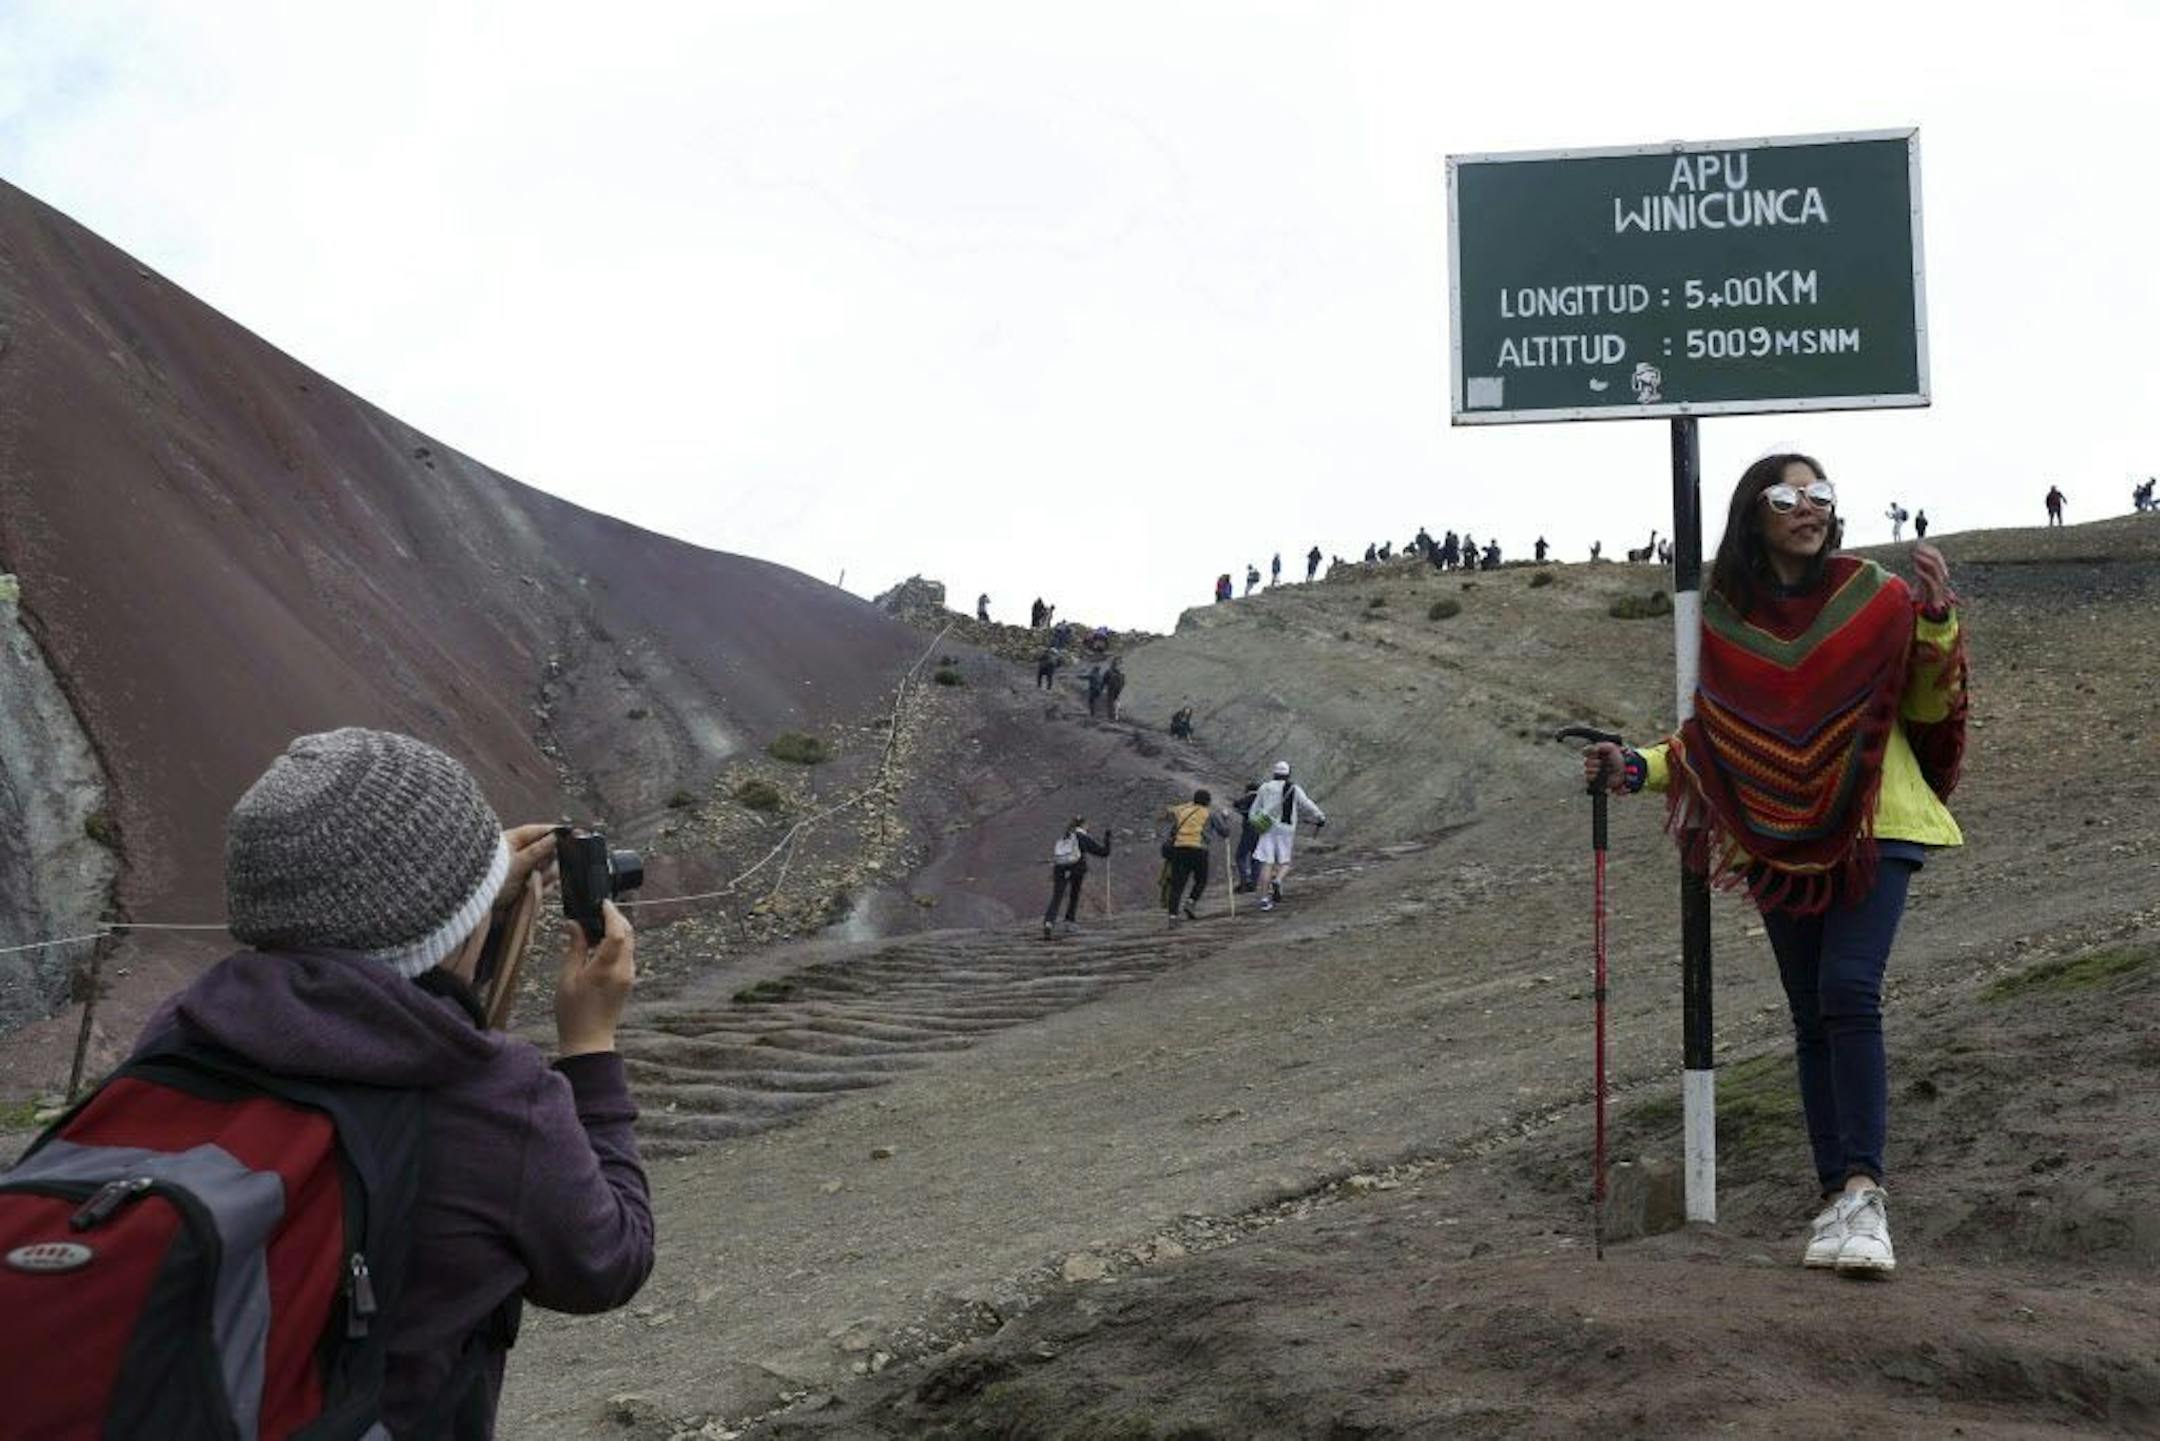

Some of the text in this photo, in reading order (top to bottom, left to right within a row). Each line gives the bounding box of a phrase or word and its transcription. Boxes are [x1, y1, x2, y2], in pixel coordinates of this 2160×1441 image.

[1669, 152, 1749, 193] APU
[1614, 186, 1829, 233] WINICUNCA
[1500, 284, 1650, 318] LONGITUD
[1684, 269, 1817, 310] 5+00KM
[1497, 334, 1626, 368] ALTITUD
